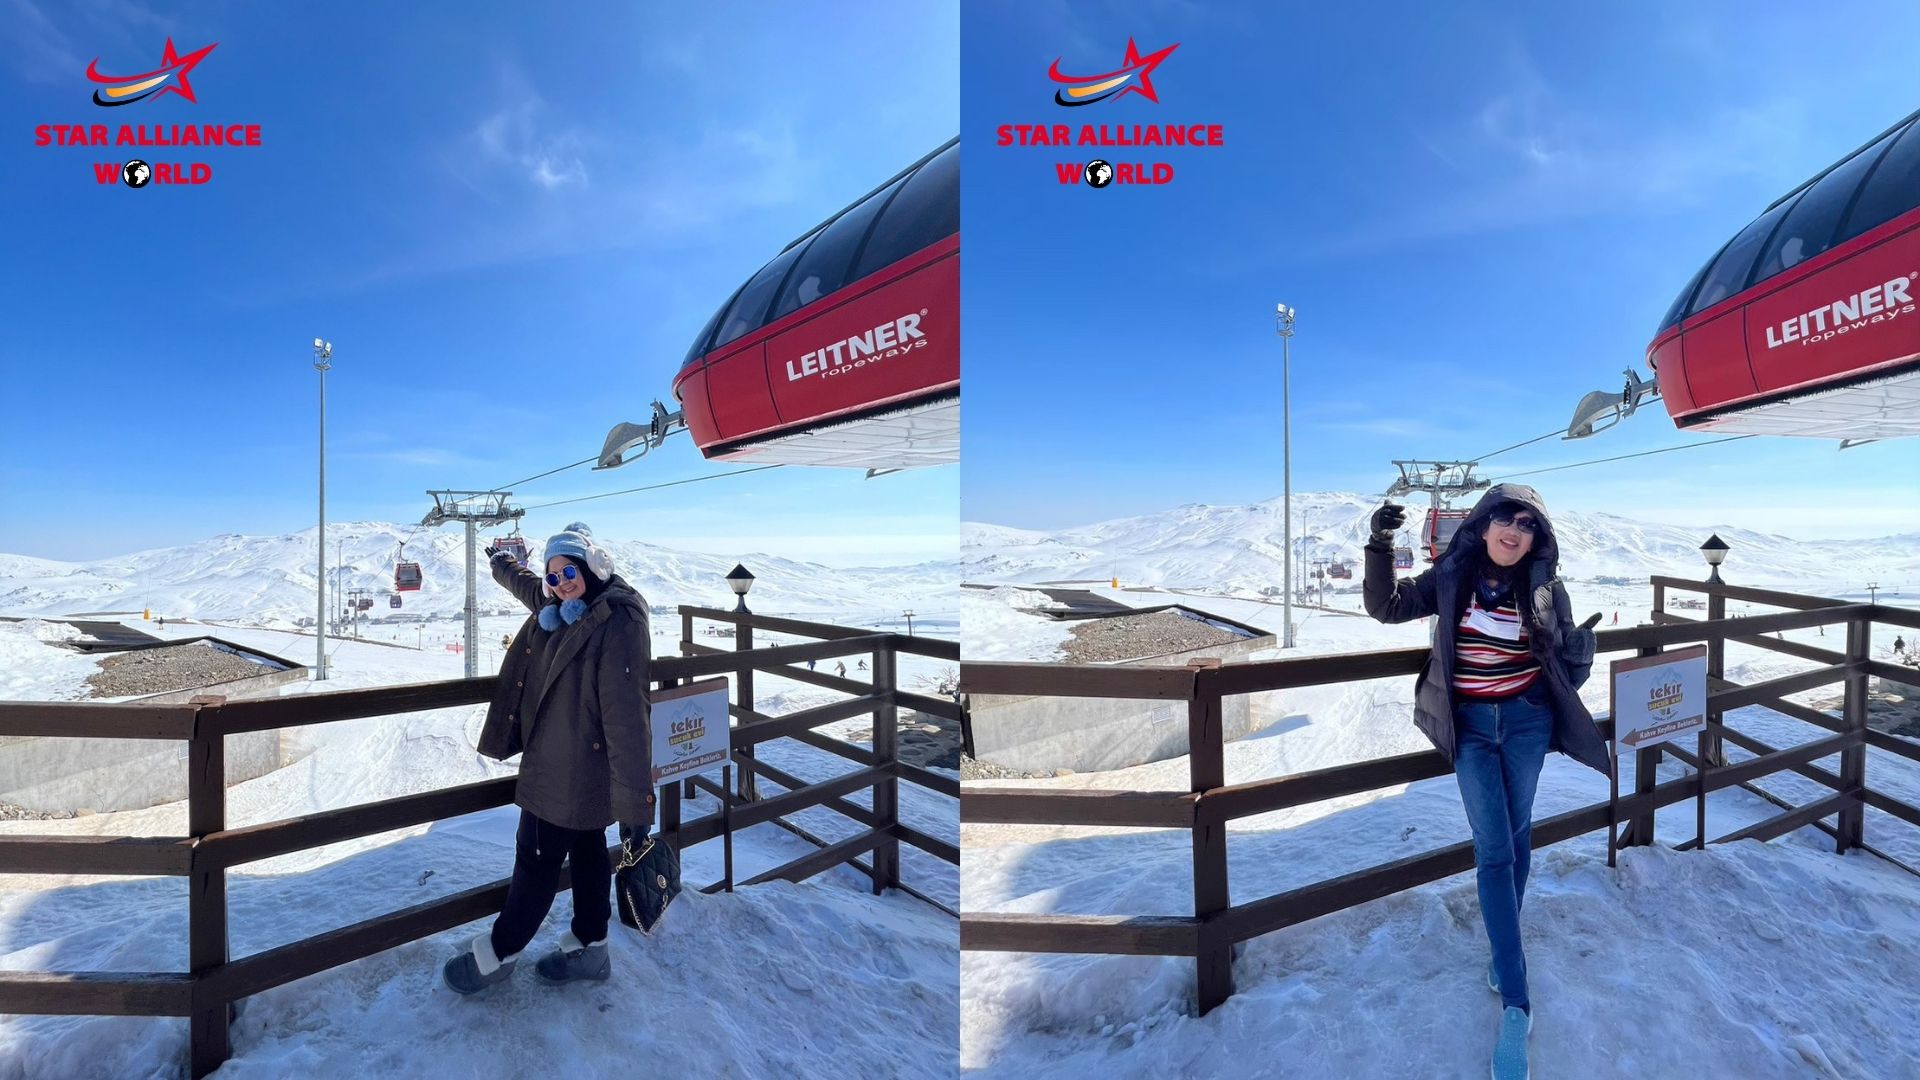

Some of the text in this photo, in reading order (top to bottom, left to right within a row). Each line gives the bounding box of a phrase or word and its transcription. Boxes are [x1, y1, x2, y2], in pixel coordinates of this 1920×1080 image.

[1802, 303, 1916, 346] ropeways
[821, 338, 928, 379] ropeways
[661, 765, 679, 776] Kahve
